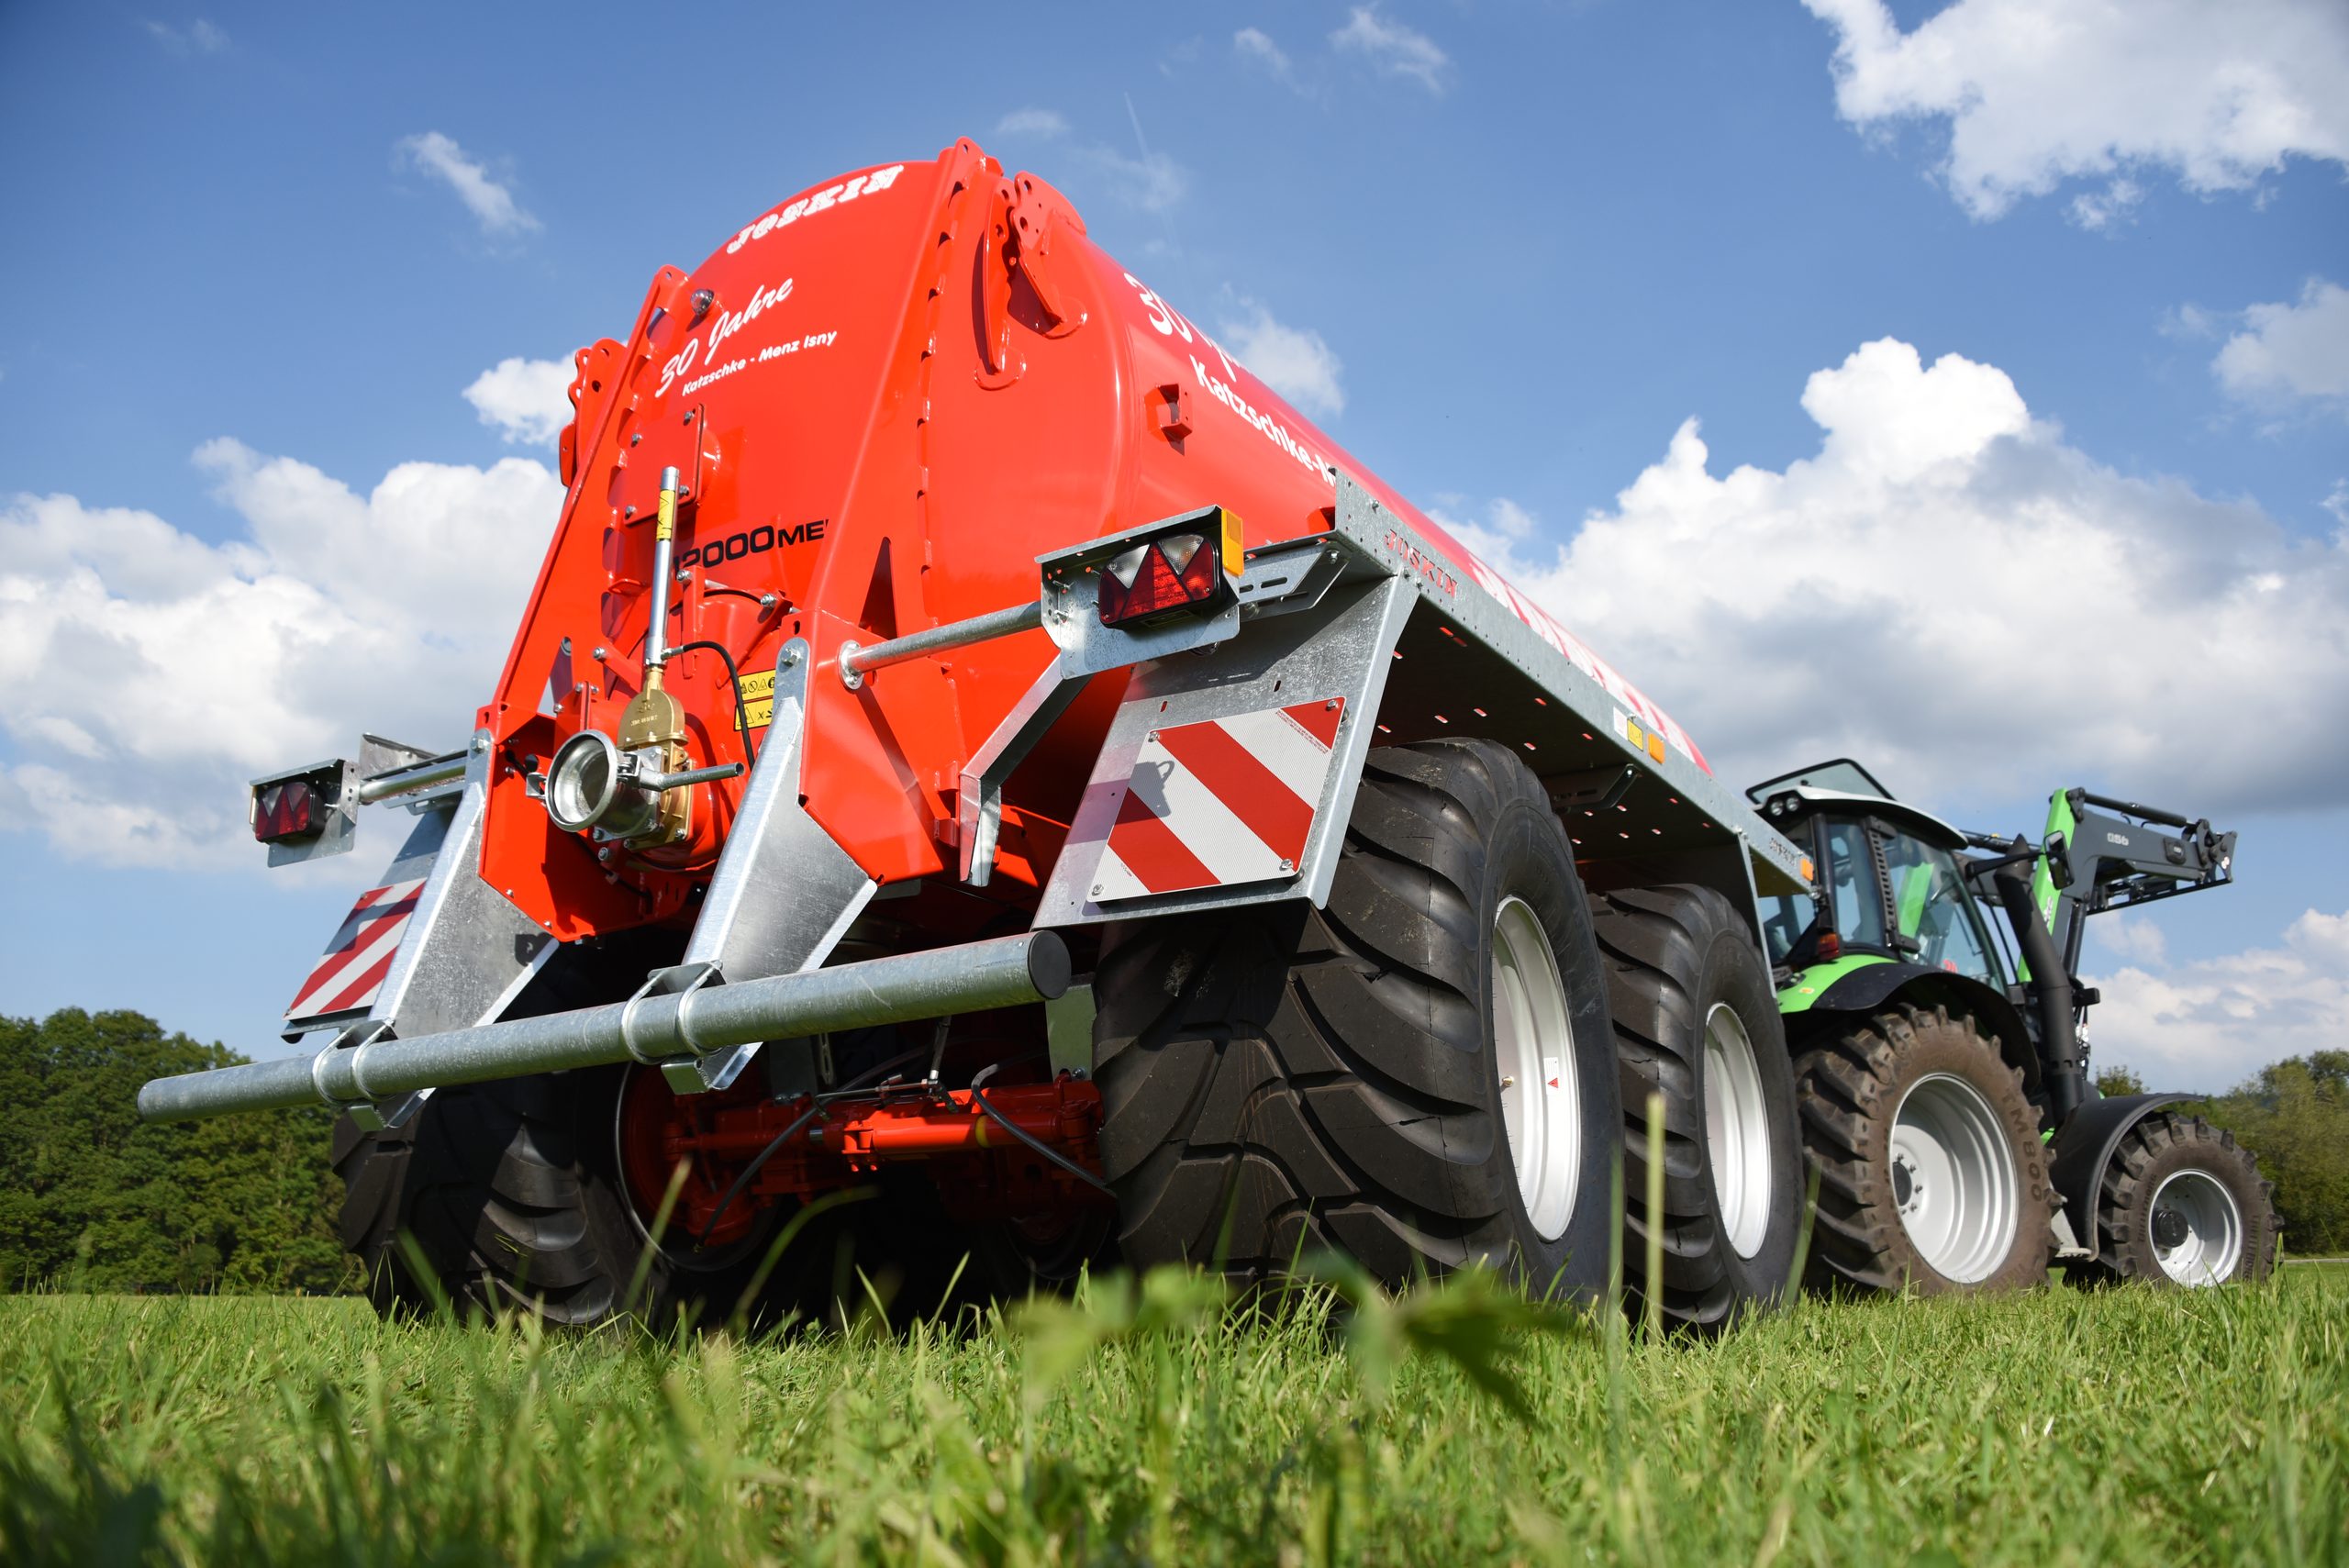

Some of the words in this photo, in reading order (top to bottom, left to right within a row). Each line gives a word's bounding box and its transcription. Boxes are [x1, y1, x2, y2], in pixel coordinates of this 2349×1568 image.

[726, 164, 904, 254] JOSKIN
[654, 338, 698, 398] 30
[704, 277, 794, 366] Jahre
[682, 359, 747, 396] Katzschke
[758, 341, 799, 362] Menz
[804, 330, 838, 350] Isny
[1384, 528, 1459, 599] JOSKIN
